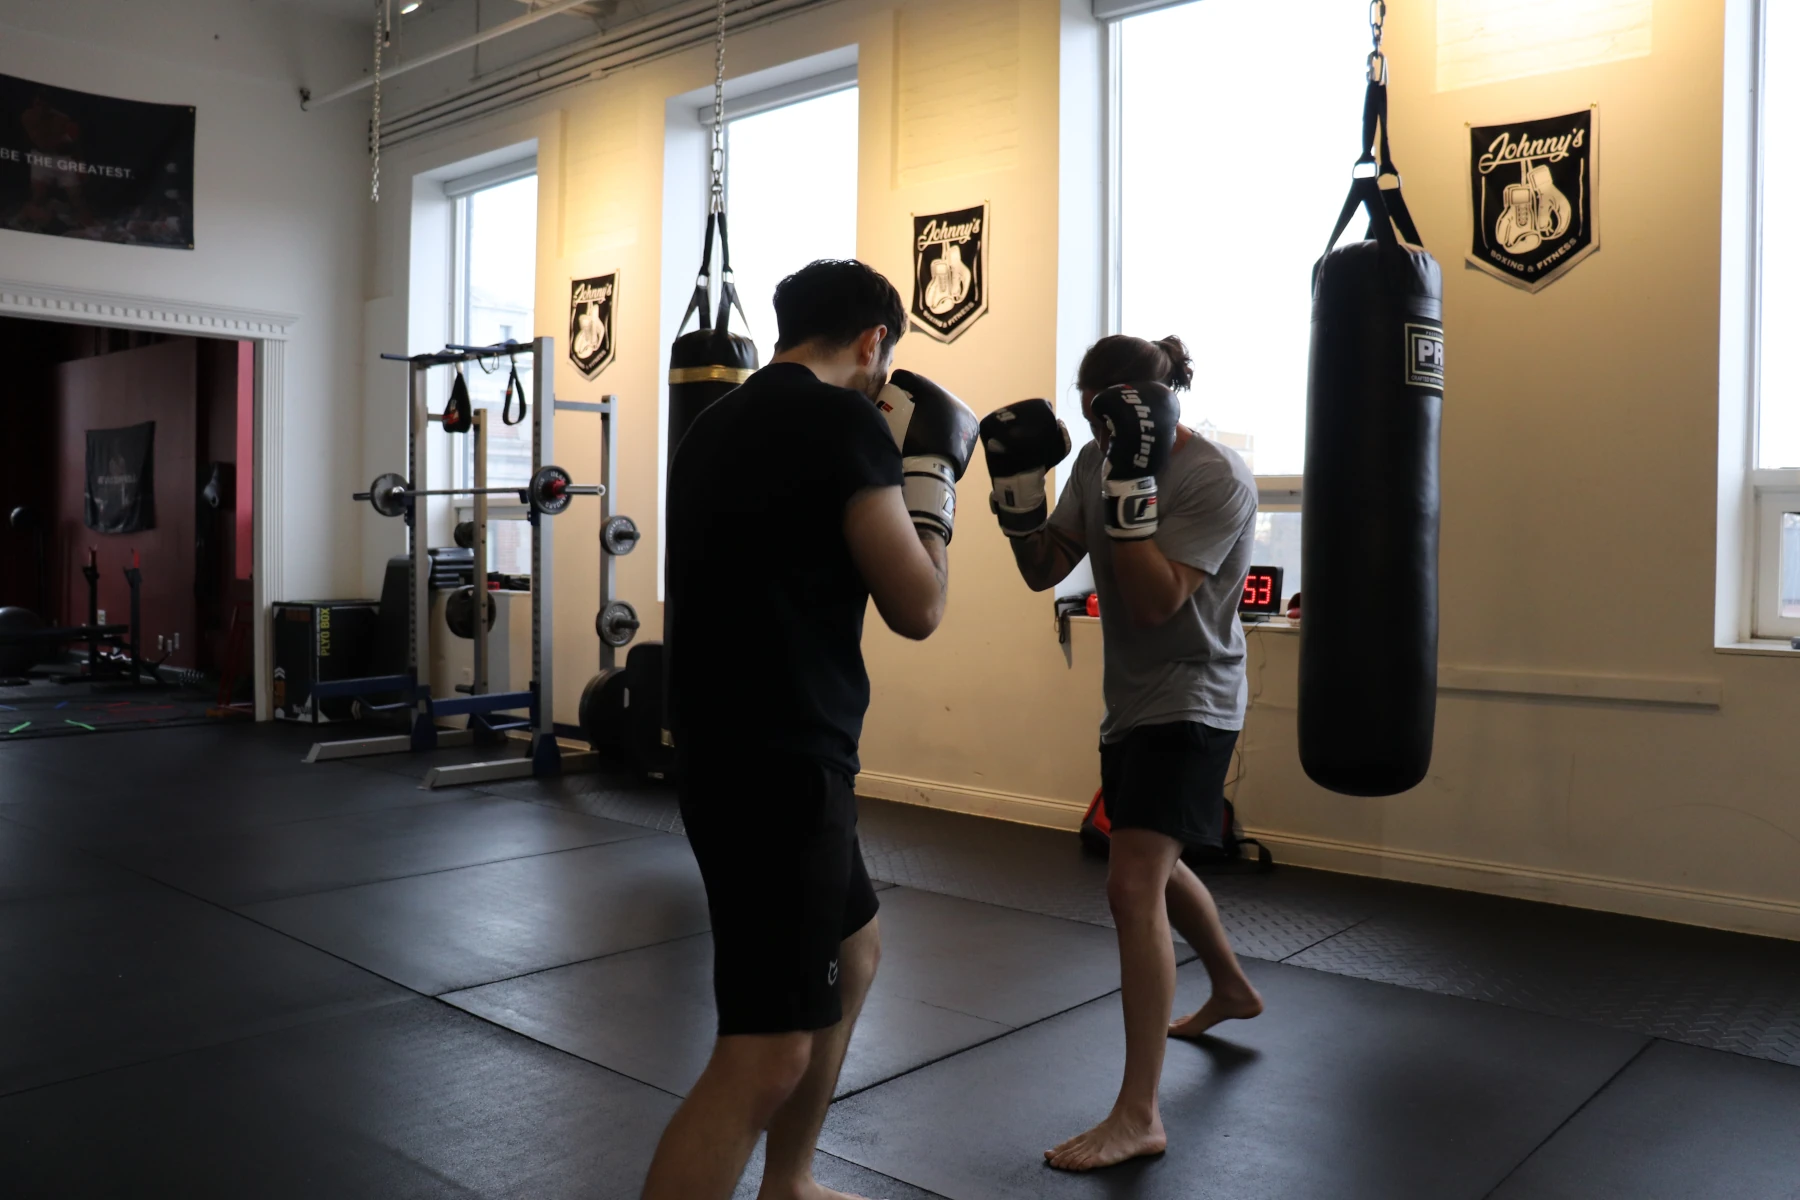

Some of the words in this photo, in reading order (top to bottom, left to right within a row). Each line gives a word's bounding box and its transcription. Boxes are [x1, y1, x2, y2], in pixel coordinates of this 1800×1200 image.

[0, 147, 20, 162] BE
[25, 153, 53, 168] THE
[57, 159, 136, 179] GREATEST.
[1478, 128, 1585, 174] Johnny's
[917, 218, 981, 251] Johnny's
[1490, 249, 1524, 272] BOXING
[1536, 237, 1577, 270] FITNESS
[573, 283, 613, 308] Johnny's
[948, 301, 975, 326] FITNESS
[1243, 575, 1273, 605] 53
[320, 607, 330, 629] BOX
[320, 631, 330, 656] PLYO
